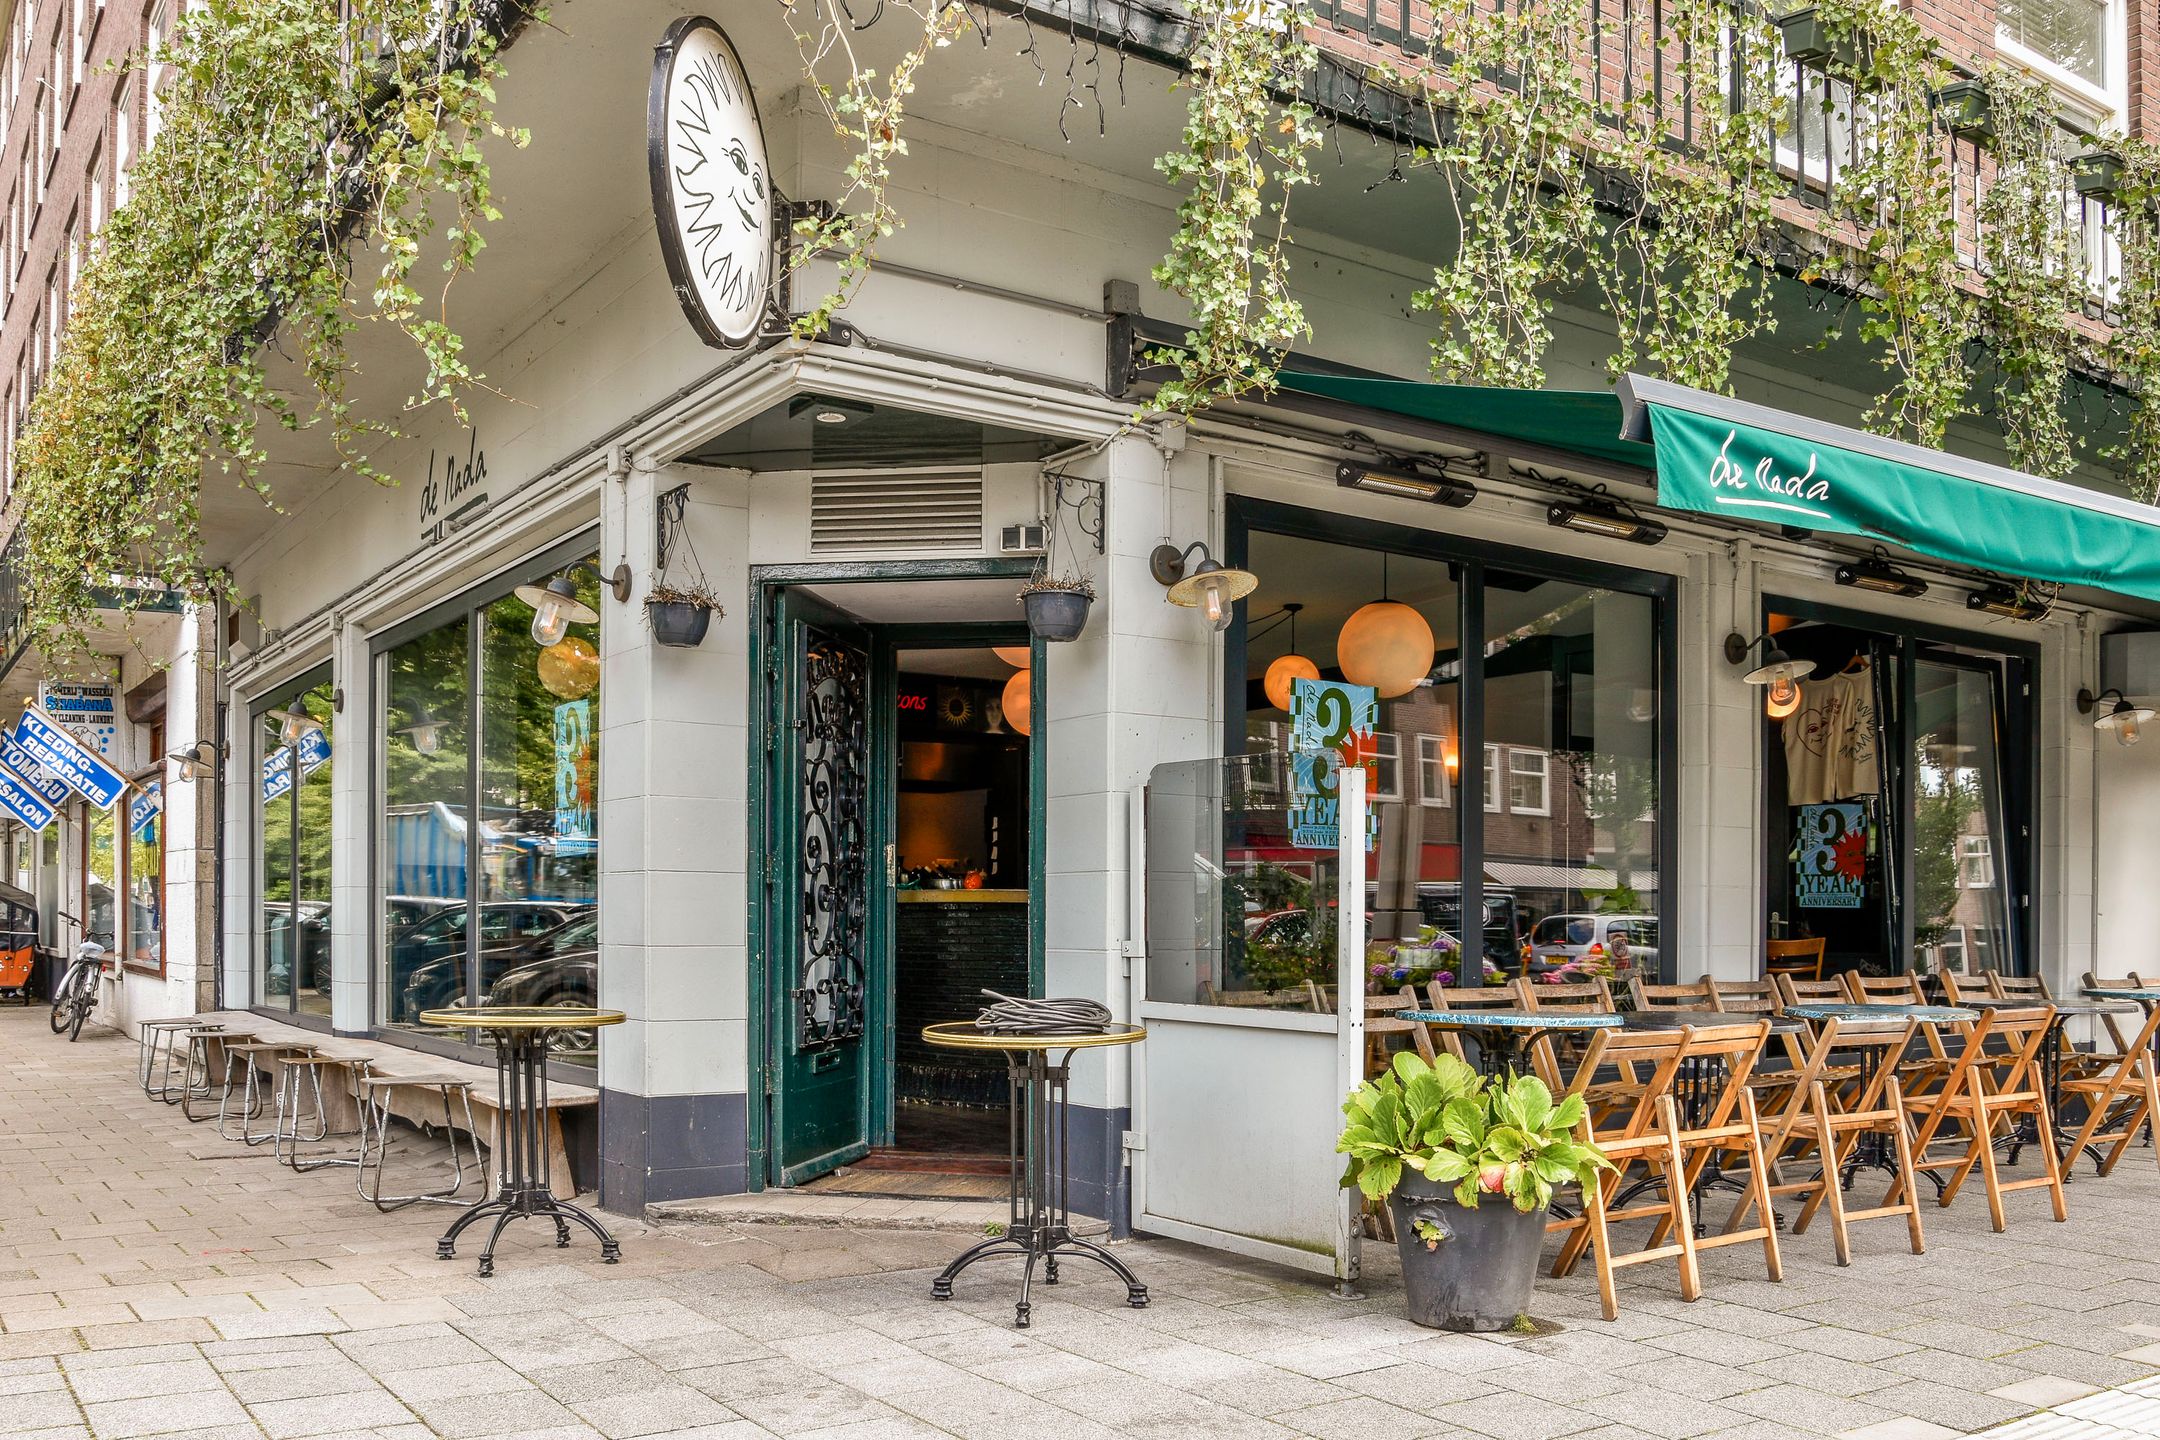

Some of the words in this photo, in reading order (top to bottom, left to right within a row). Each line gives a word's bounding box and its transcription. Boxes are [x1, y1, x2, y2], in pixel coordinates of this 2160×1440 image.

[420, 449, 438, 523] de
[46, 696, 113, 712] SHABANA
[22, 715, 95, 774] KLEDING-
[22, 736, 109, 804] REPARATIE
[1801, 897, 1857, 906] ANNIVERSARY
[1803, 874, 1856, 893] YEAR
